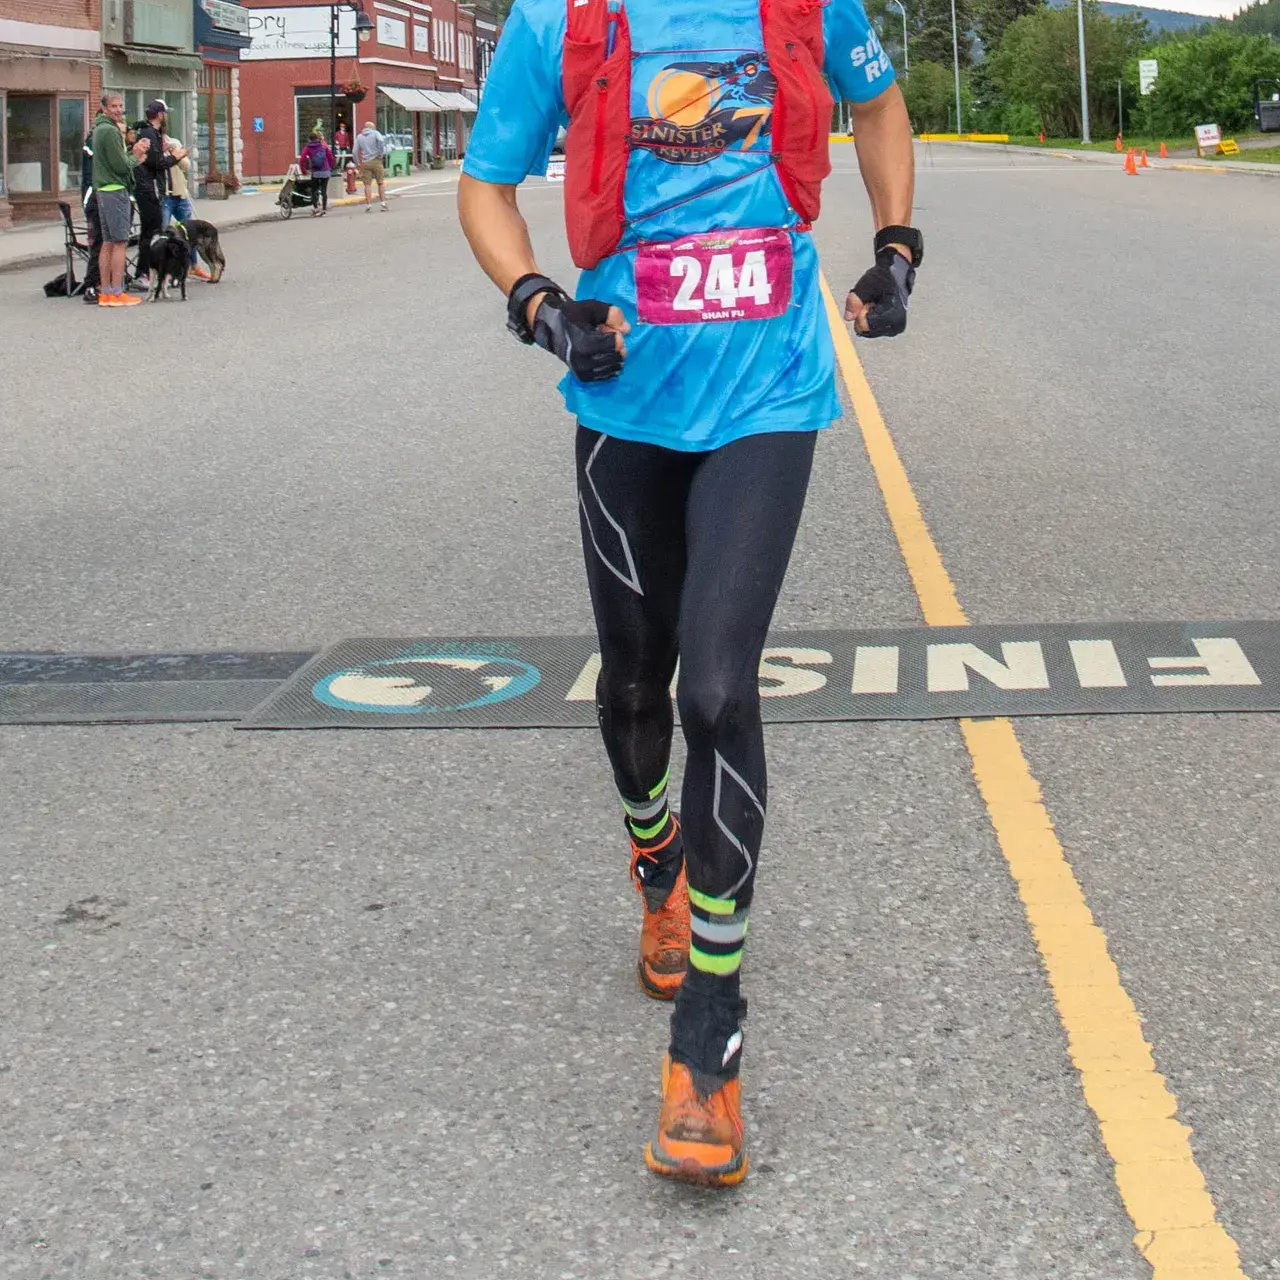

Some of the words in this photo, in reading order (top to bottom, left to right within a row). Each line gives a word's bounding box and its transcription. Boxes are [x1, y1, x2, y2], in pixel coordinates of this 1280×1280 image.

[631, 122, 728, 145] SINISTER
[670, 250, 772, 311] 244
[702, 310, 729, 320] SHAN
[731, 309, 745, 318] FU
